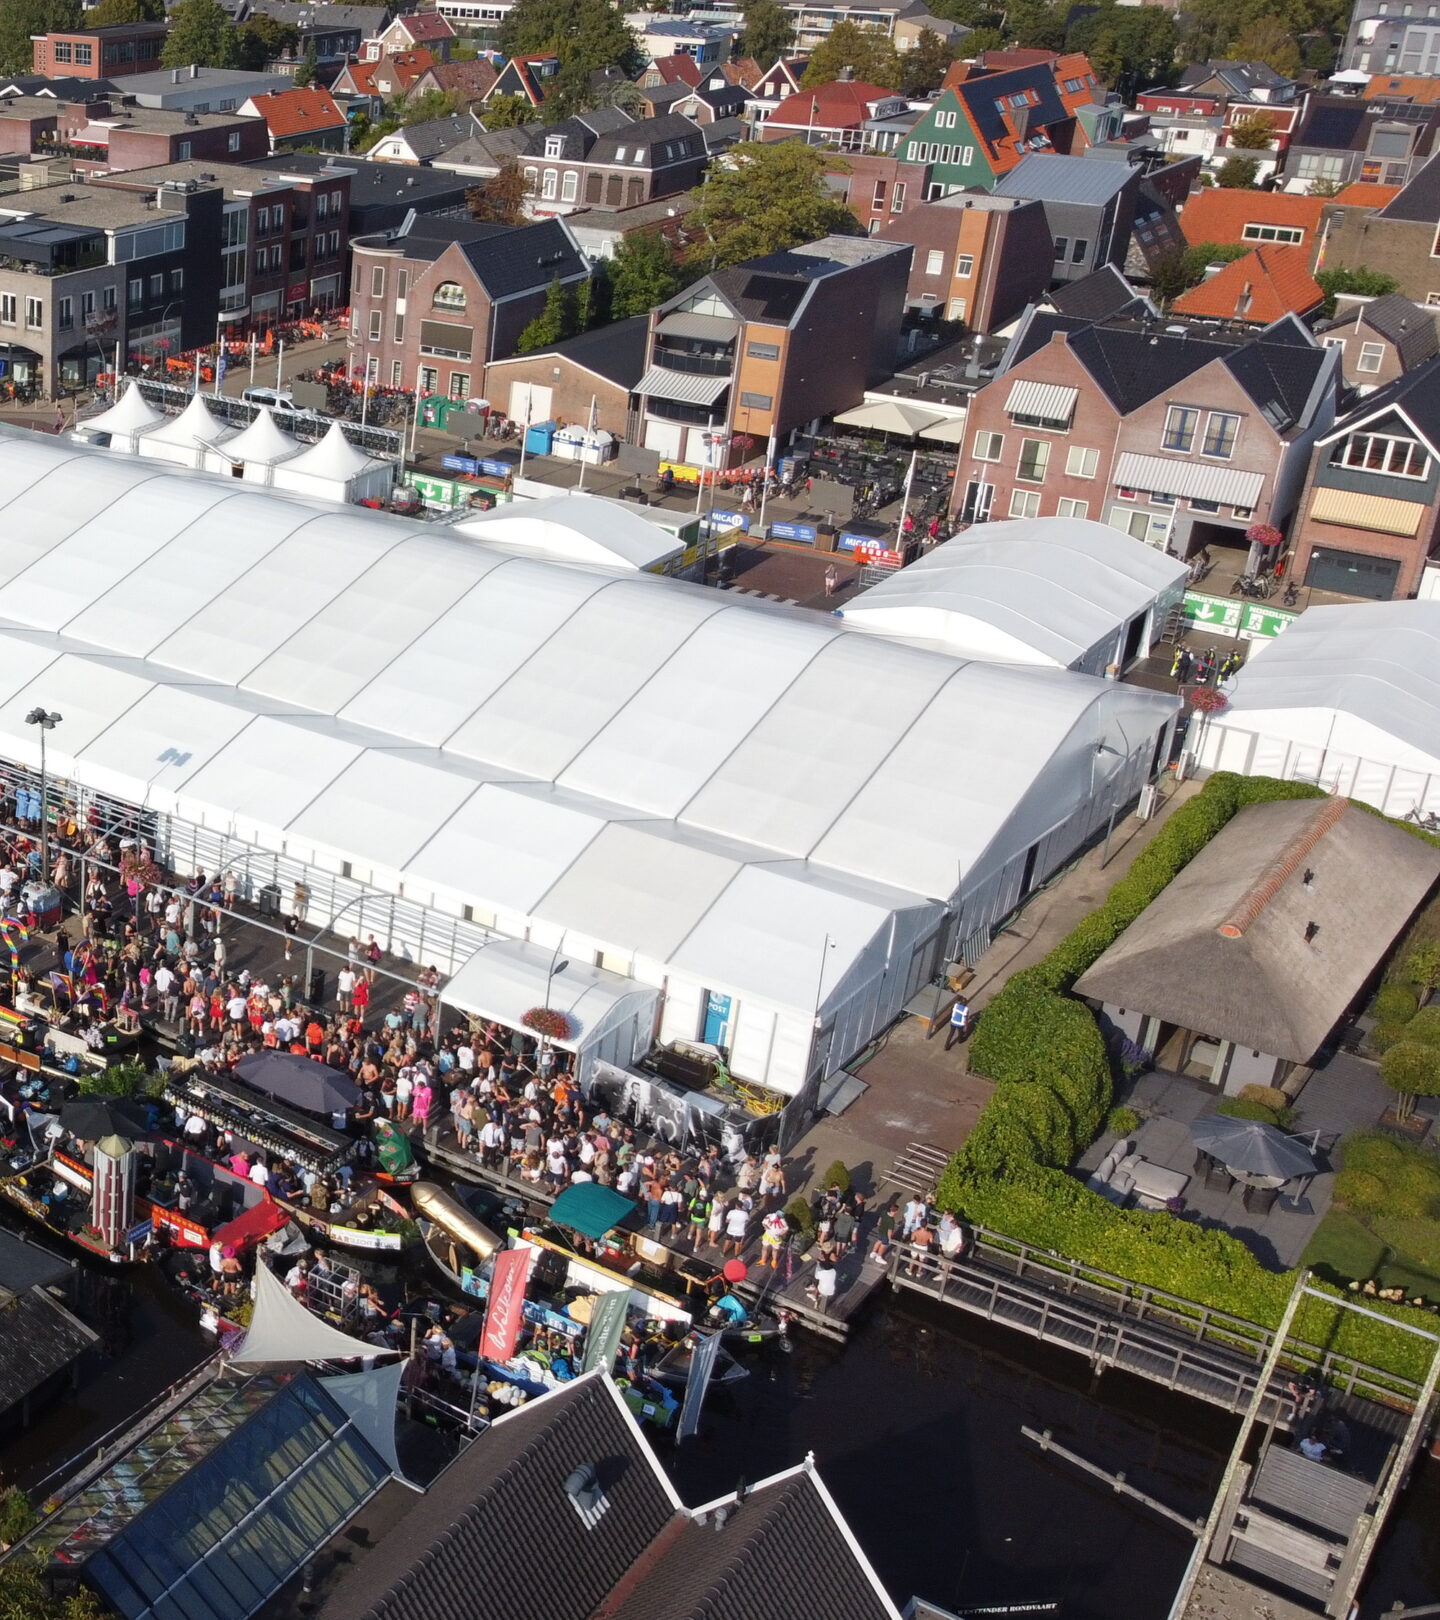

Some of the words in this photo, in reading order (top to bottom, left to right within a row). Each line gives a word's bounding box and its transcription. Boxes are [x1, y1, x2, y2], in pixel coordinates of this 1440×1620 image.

[712, 512, 731, 523] MICA
[487, 1258, 515, 1350] Welkom
[1009, 1603, 1057, 1612] RONDVAART
